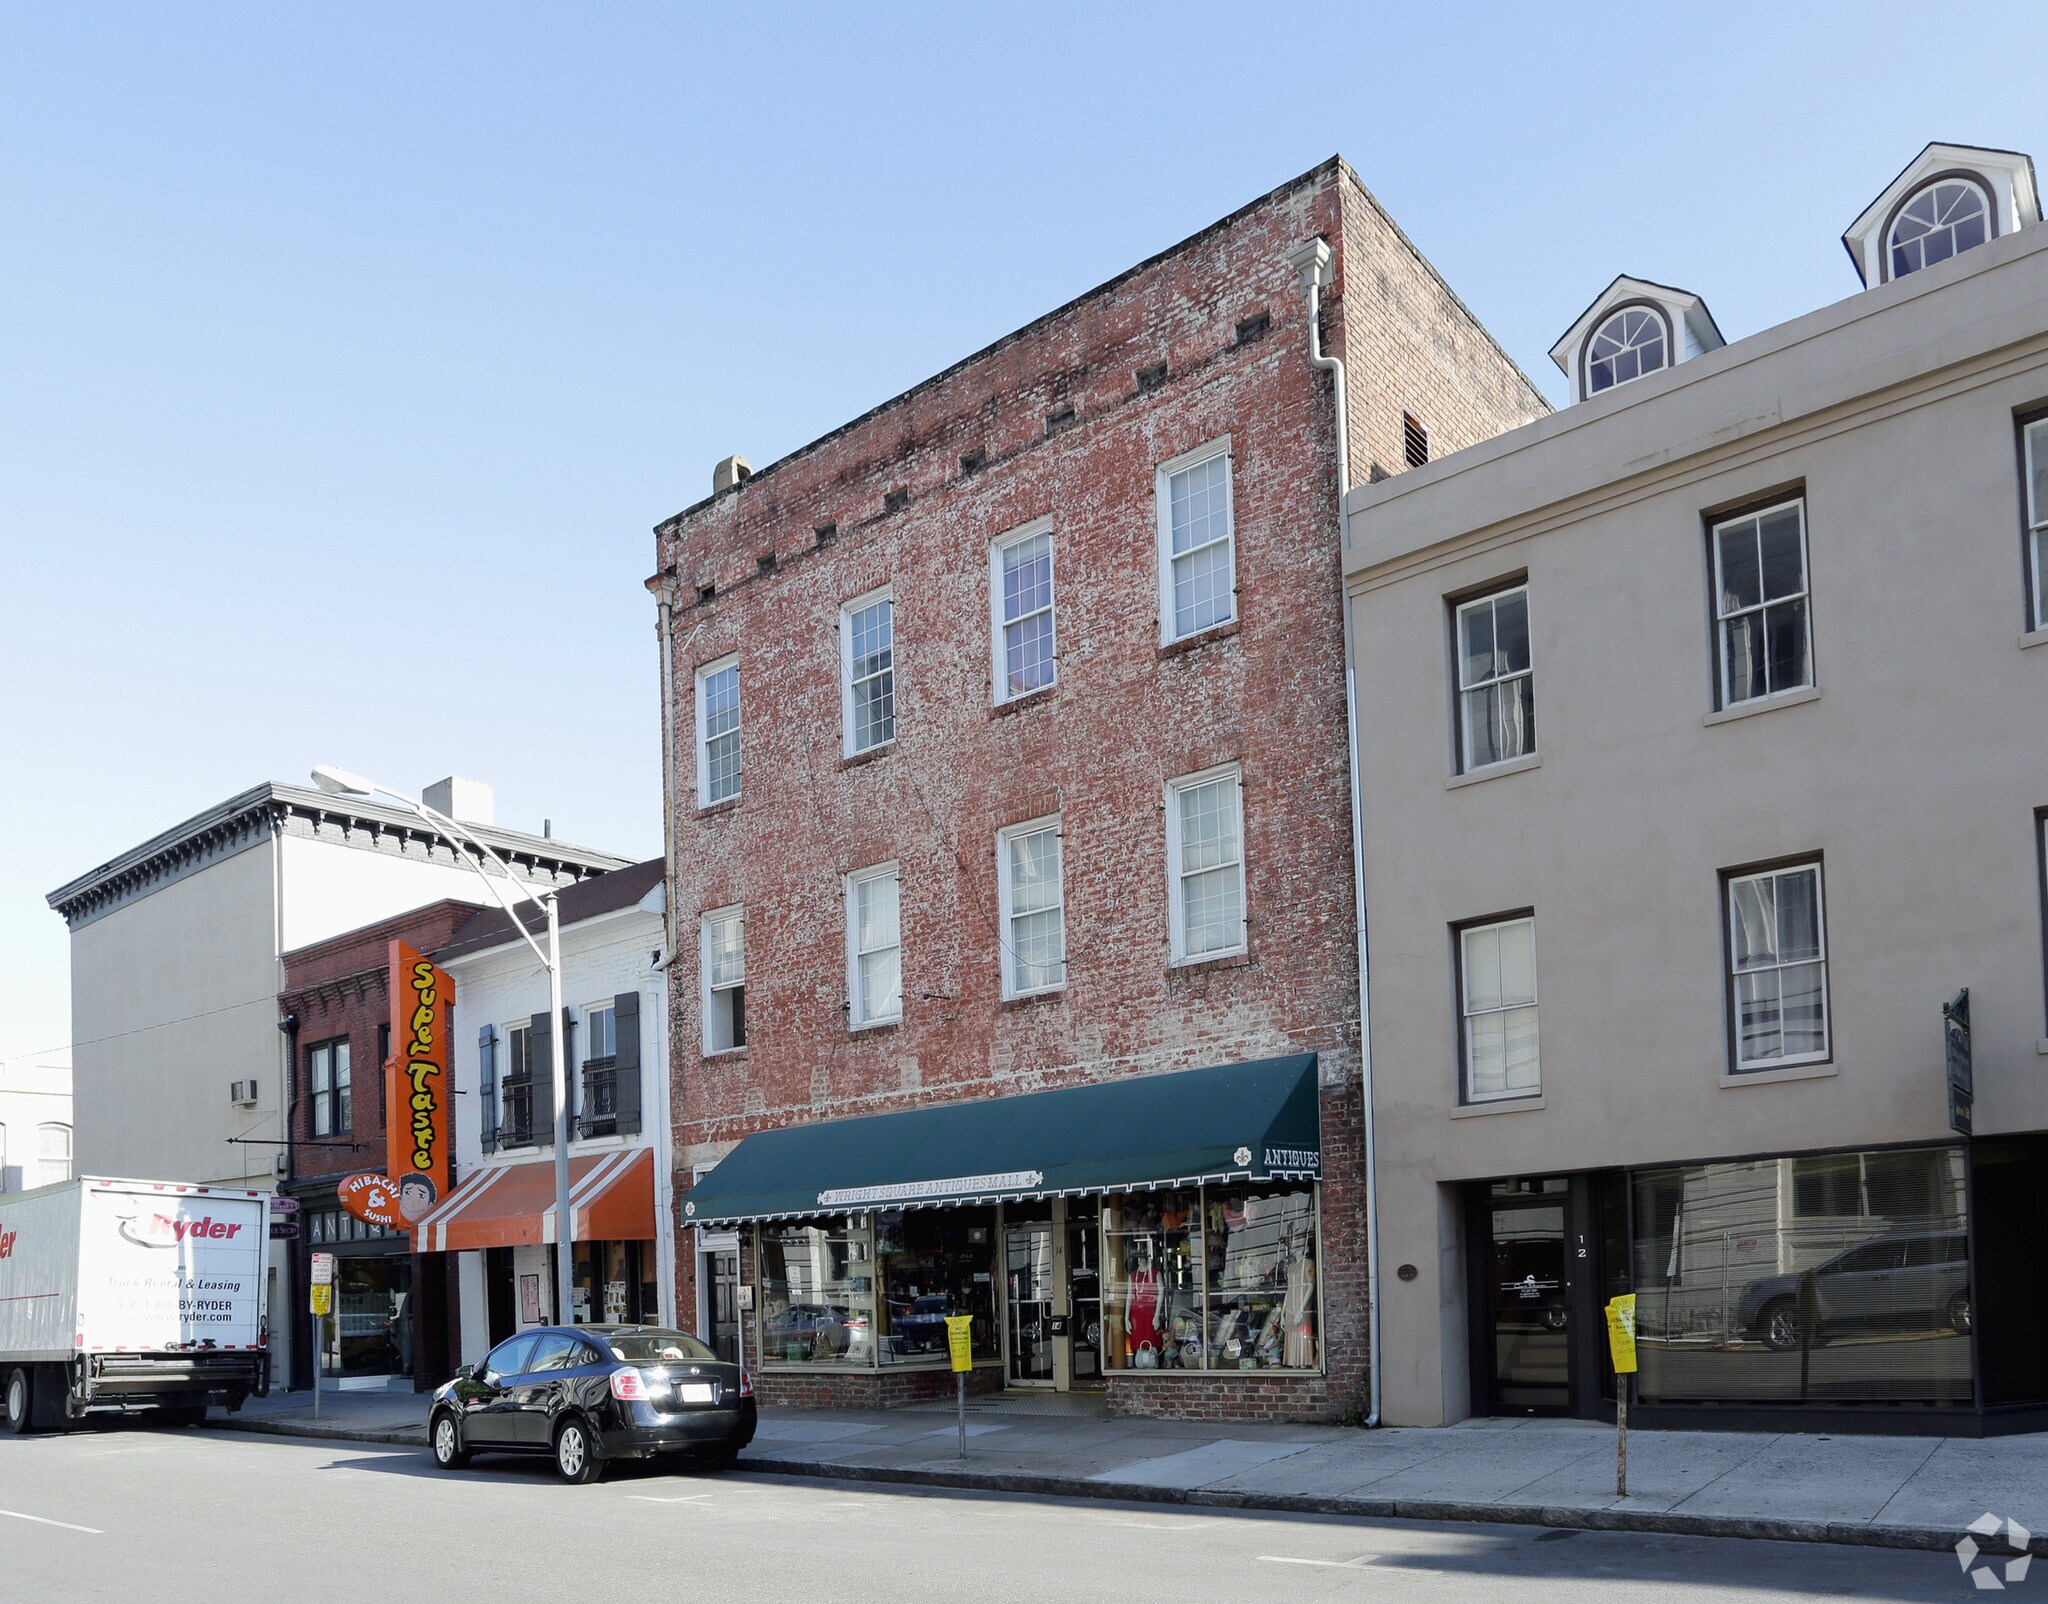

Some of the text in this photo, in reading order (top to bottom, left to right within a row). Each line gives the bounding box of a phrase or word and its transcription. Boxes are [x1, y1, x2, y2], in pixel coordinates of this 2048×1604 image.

[407, 1061, 440, 1170] Taste
[1263, 1148, 1320, 1168] ANTIQUES
[349, 1175, 400, 1199] HIBACHI
[368, 1188, 386, 1208] &
[834, 1174, 1022, 1202] WRIGHT SQUARE ANTIQUES MALL
[150, 1213, 242, 1242] Ryder
[363, 1209, 392, 1224] SUSHI
[108, 1277, 139, 1288] Truck
[186, 1279, 194, 1289] &
[198, 1279, 241, 1292] Leasing
